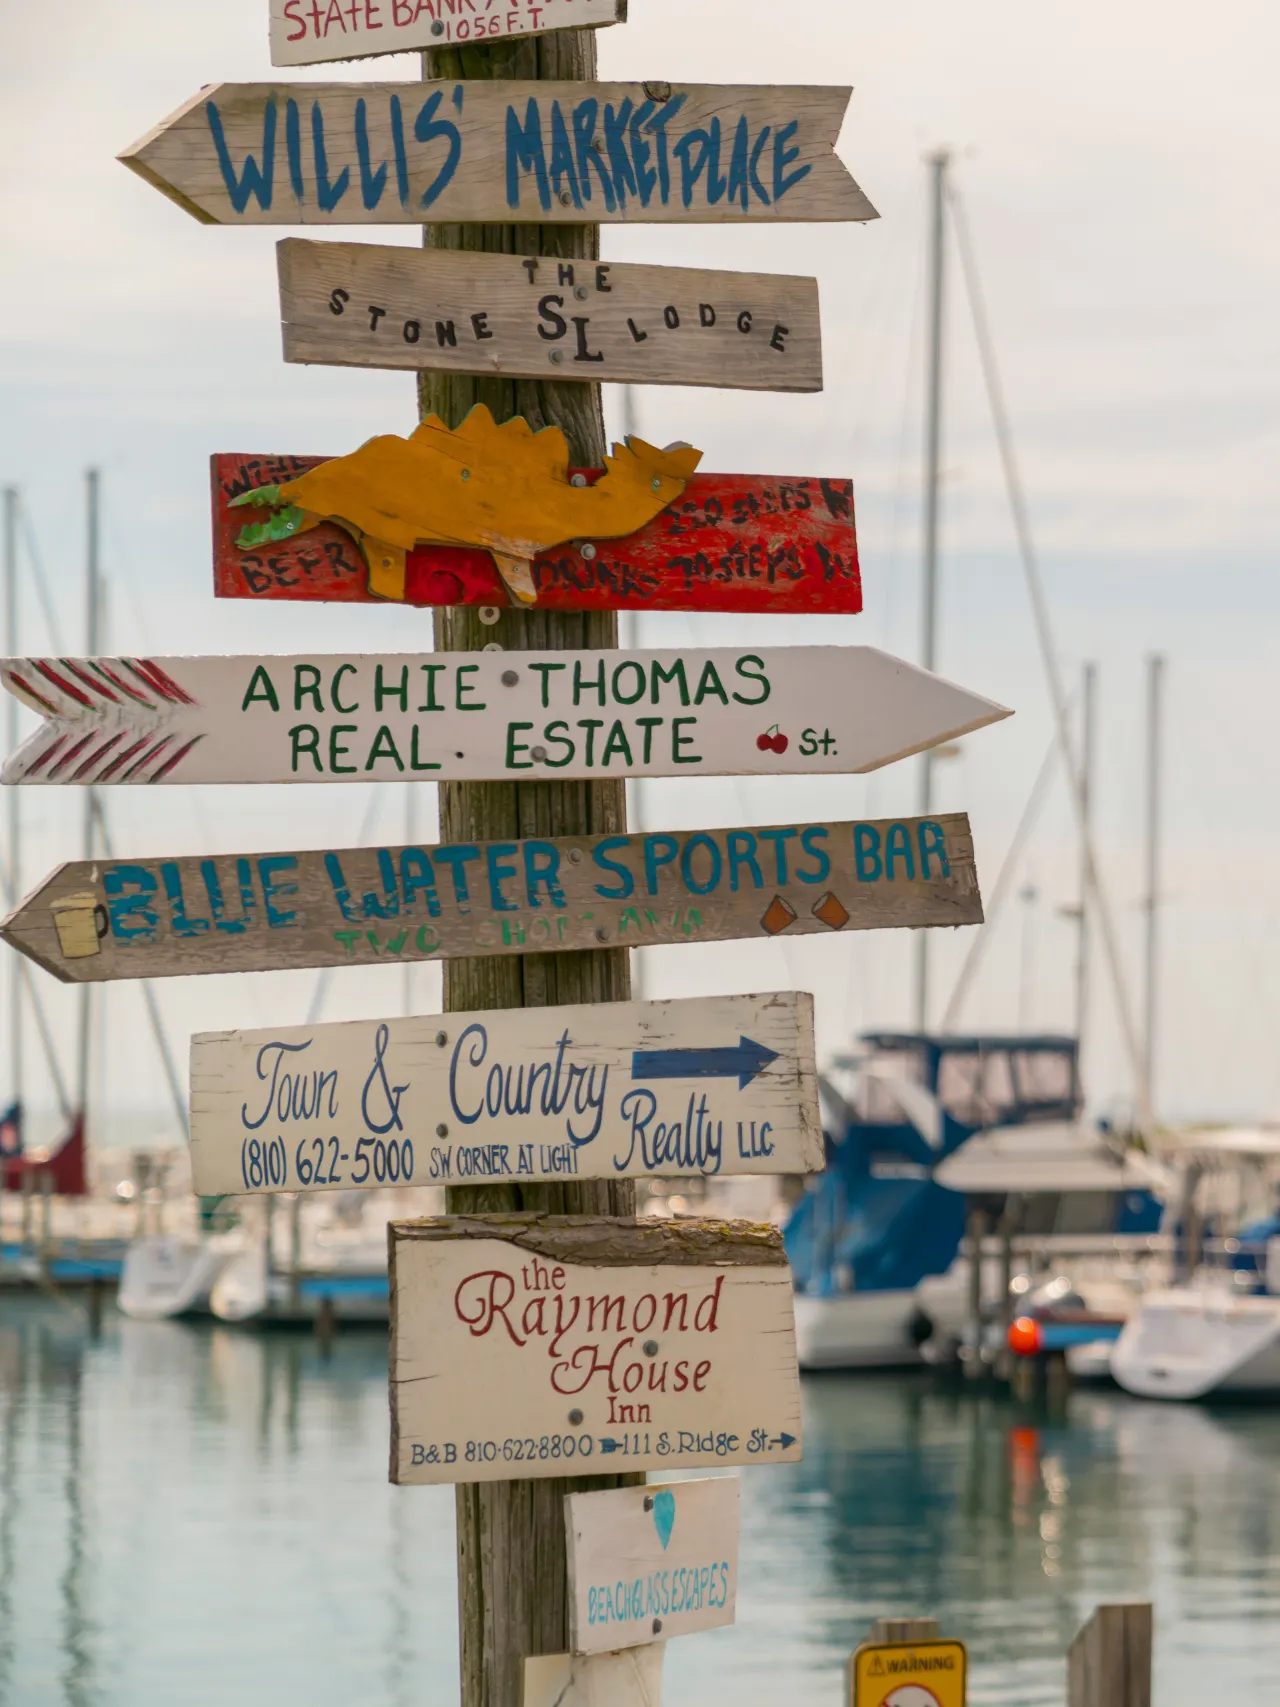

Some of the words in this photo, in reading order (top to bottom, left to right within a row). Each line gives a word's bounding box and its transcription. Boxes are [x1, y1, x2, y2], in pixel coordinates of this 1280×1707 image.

[284, 3, 383, 41] STATE
[446, 15, 501, 41] 1056
[522, 259, 612, 293] THE
[328, 288, 493, 348] STONE
[627, 303, 789, 352] LODGE
[242, 665, 486, 714] ARCHIE
[529, 655, 772, 709] THOMAS
[288, 722, 442, 774] REAL
[506, 717, 704, 768] ESTATE
[798, 728, 839, 757] St.
[103, 855, 300, 946] BLUE
[324, 841, 567, 923] WATER
[592, 826, 831, 899] SPORTS
[853, 821, 950, 883] BAR
[334, 924, 442, 957] TWO
[618, 907, 724, 938] AWA
[241, 1037, 339, 1130] Town
[361, 1023, 411, 1135] &
[449, 1023, 610, 1146] Country
[614, 1088, 723, 1176] Realty
[736, 1121, 776, 1158] LLC
[241, 1134, 287, 1189] (810)
[296, 1136, 414, 1186] 622-5000
[456, 1144, 513, 1177] CORNER
[540, 1143, 579, 1173] LIGHT
[522, 1258, 566, 1291] the
[454, 1270, 725, 1358] Raymond
[550, 1337, 712, 1395] House
[606, 1396, 652, 1424] Inn
[411, 1443, 457, 1465] B&B
[622, 1431, 651, 1455] 111
[747, 1428, 773, 1453] St.
[887, 1655, 955, 1673] WARNING
